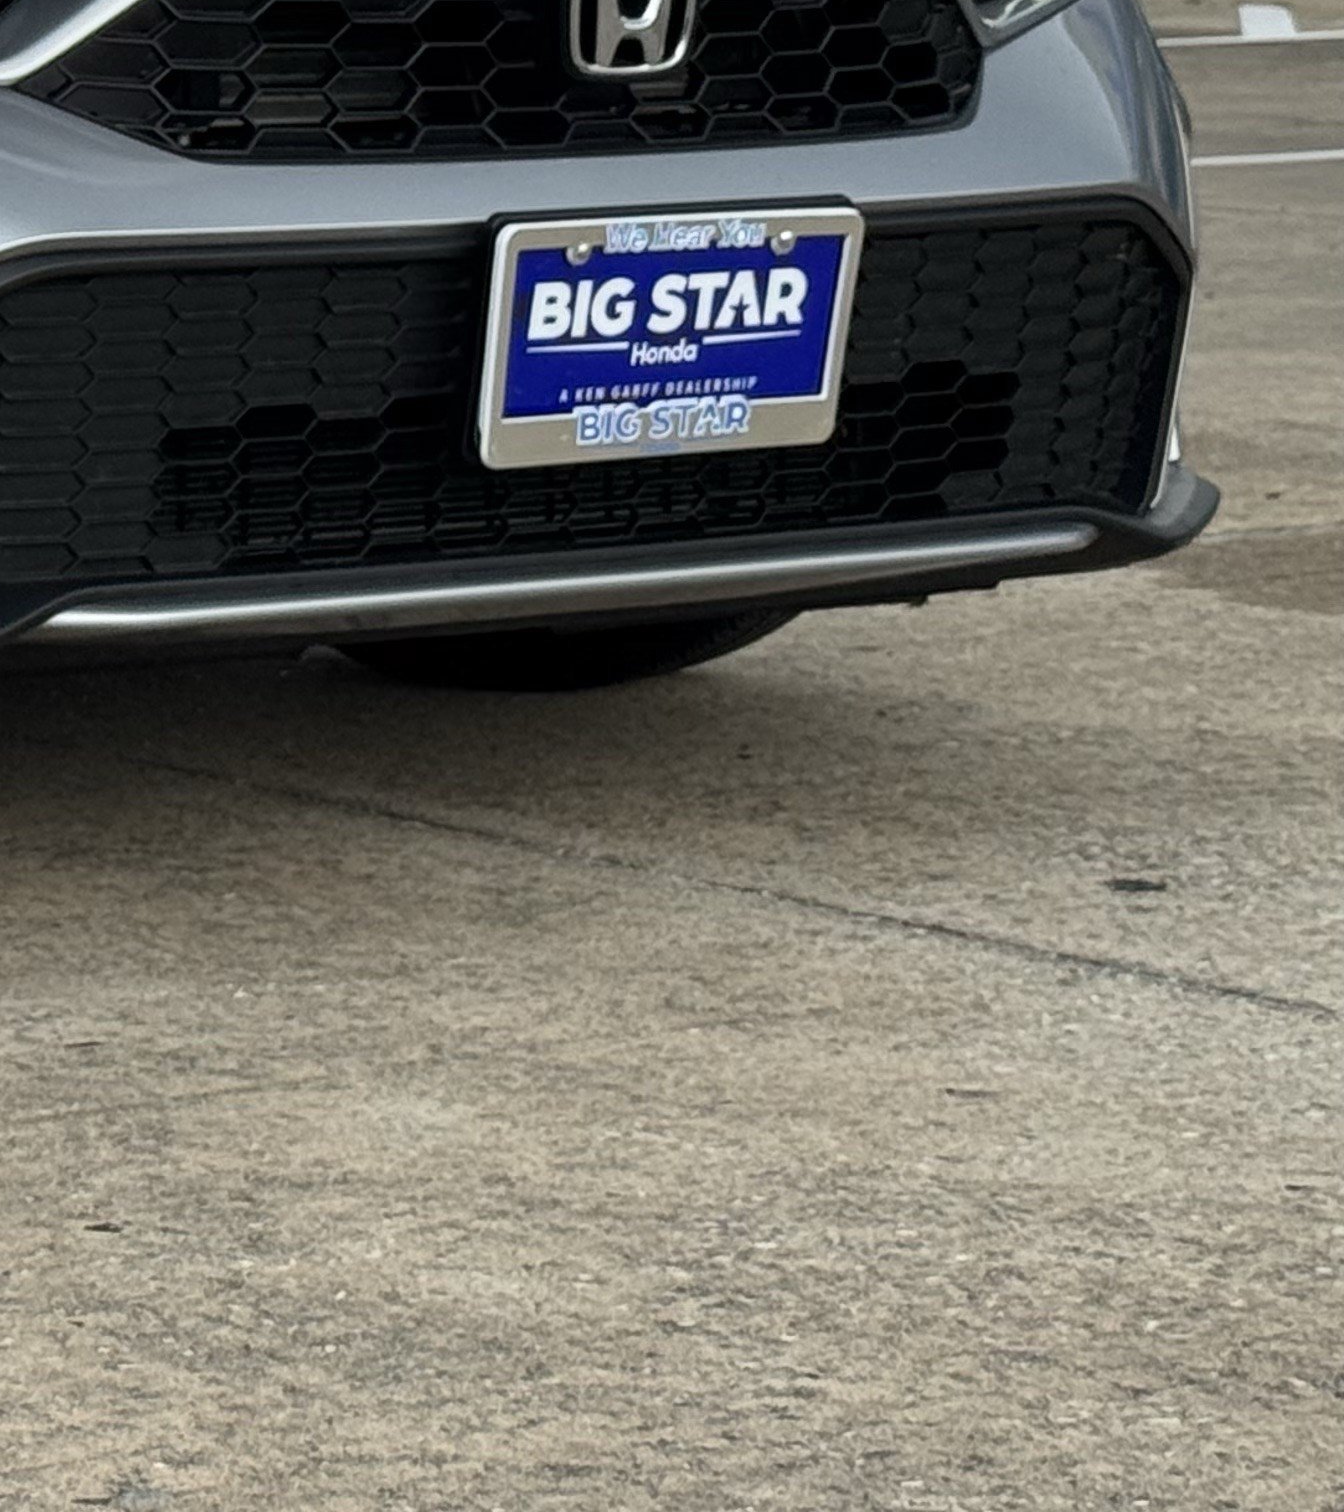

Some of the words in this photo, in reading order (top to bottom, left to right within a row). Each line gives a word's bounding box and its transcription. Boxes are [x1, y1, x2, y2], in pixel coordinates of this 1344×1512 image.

[604, 222, 648, 254] We
[648, 220, 716, 251] Hear
[716, 218, 768, 249] You
[526, 277, 637, 341] BIG
[645, 266, 809, 334] STAR
[629, 341, 699, 367] Honda
[558, 389, 569, 403] A
[574, 387, 606, 403] KEN
[610, 382, 661, 400] GARFF
[664, 375, 758, 397] DEALERSHIP
[574, 402, 642, 446] BIG
[647, 393, 752, 441] STAR
